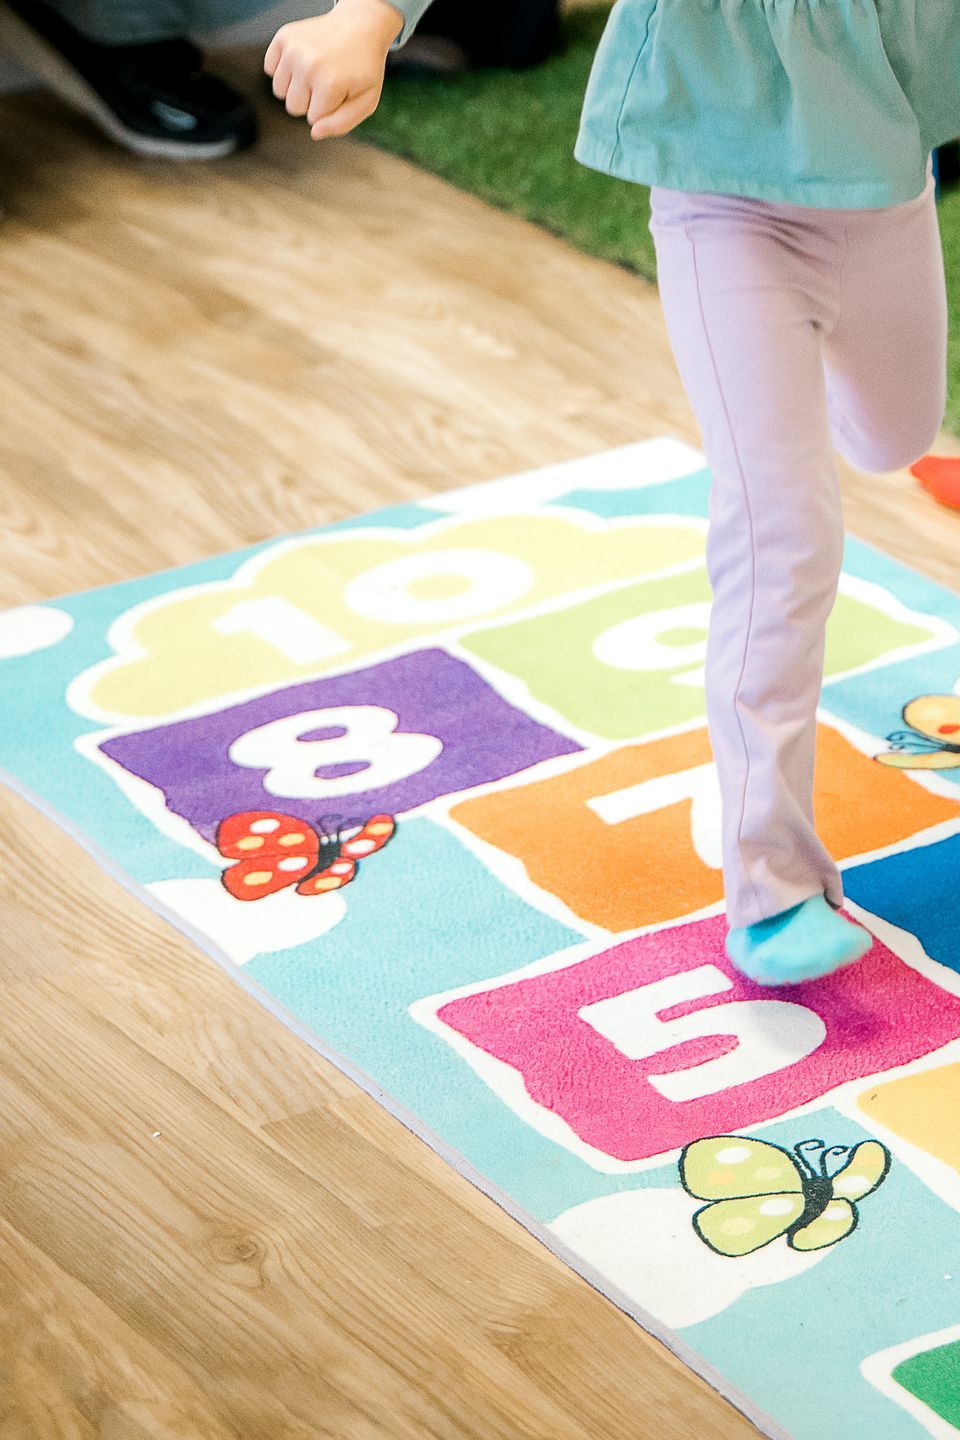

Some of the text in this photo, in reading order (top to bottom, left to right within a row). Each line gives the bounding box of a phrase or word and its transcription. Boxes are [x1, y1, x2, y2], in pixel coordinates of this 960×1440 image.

[209, 548, 535, 666] 10
[228, 704, 444, 802] 8
[576, 963, 828, 1103] 5
